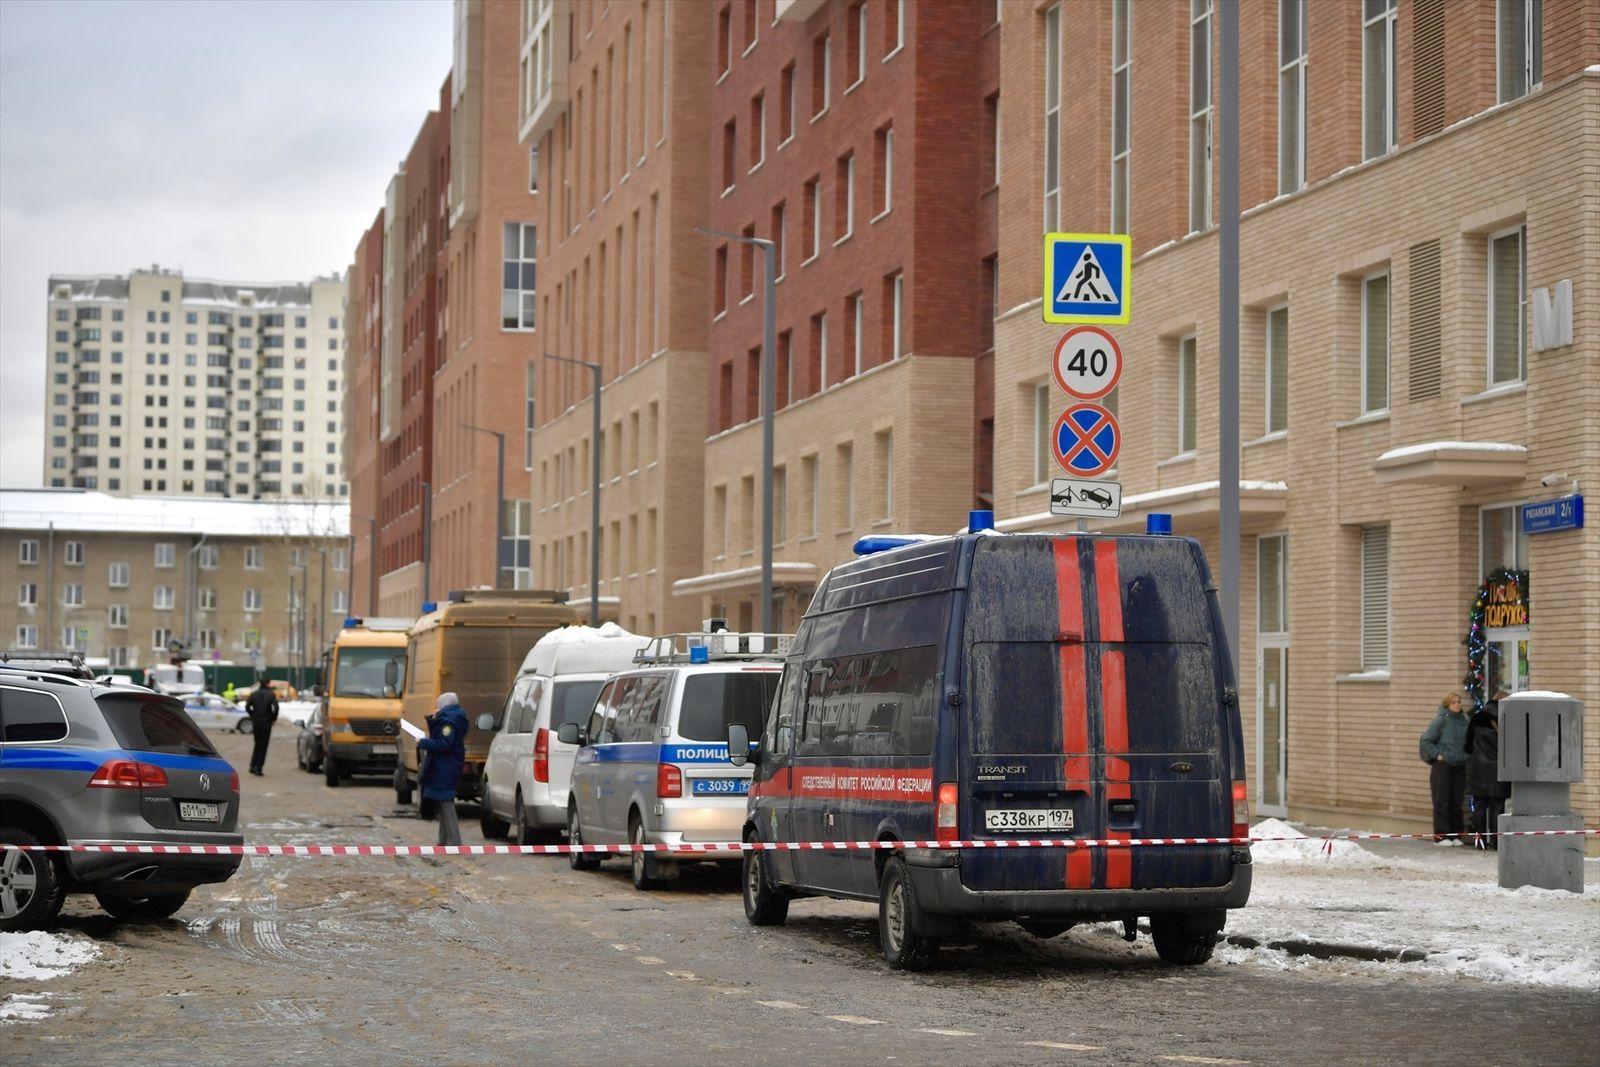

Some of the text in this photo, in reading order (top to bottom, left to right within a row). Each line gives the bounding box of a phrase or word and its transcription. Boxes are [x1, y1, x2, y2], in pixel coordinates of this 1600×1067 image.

[1067, 348, 1108, 377] 40
[676, 748, 729, 760] ПОЛИЦИ
[977, 765, 1027, 774] TRANSIT
[708, 780, 735, 792] 3039
[801, 773, 932, 795] СЛЕДСТВЕННЫЙ КОМИТЕТ РОССИЙСКОЙ ФЕДЕРАЦИИ
[990, 810, 1069, 827] С338КР 197
